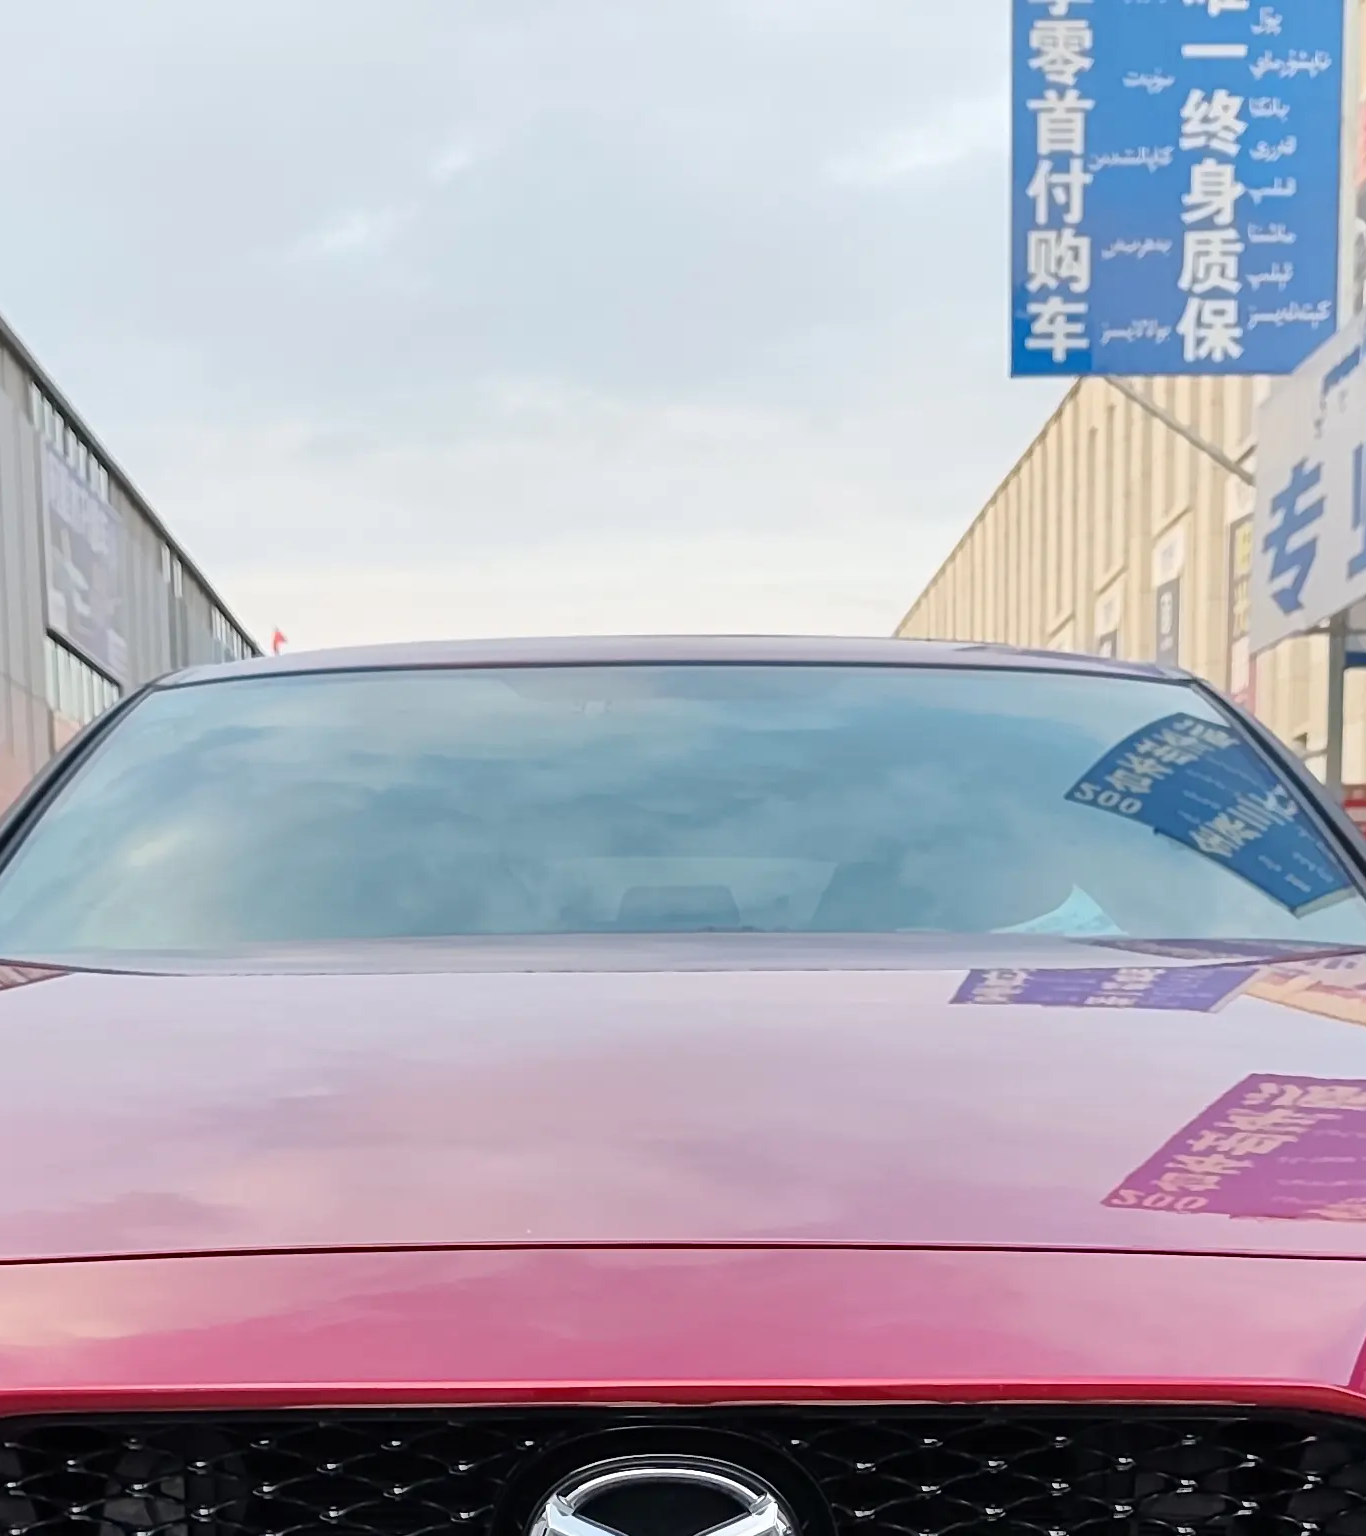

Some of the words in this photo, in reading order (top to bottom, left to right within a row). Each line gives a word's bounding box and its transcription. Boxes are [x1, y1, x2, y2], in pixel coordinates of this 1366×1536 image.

[1024, 0, 1095, 363] 零首付购车
[1176, 0, 1249, 363] 一终身质保
